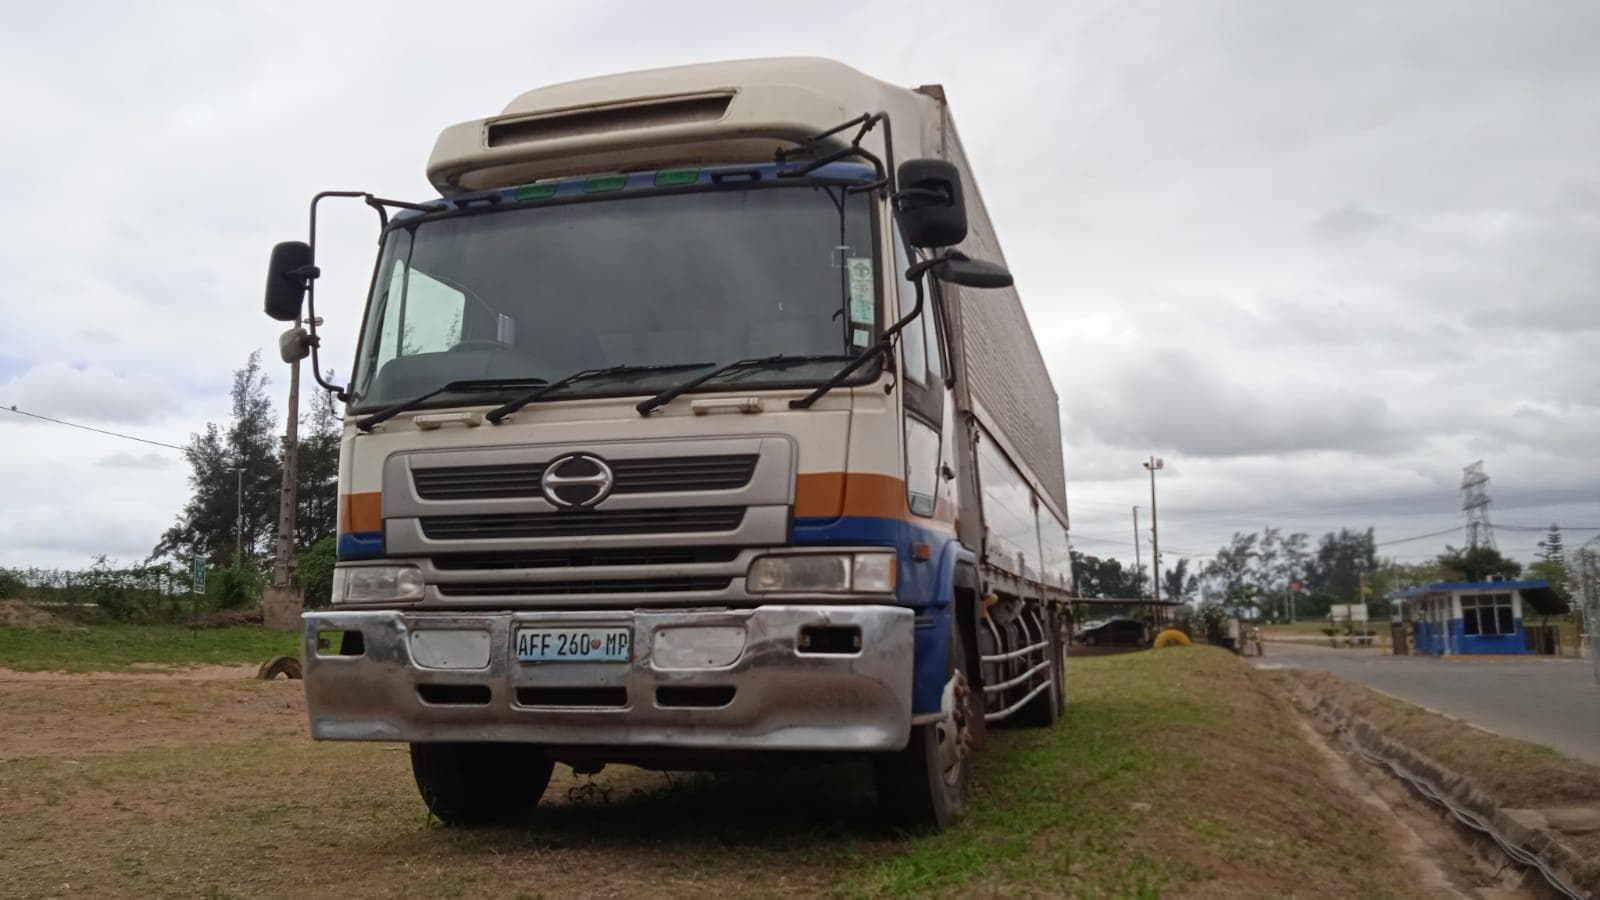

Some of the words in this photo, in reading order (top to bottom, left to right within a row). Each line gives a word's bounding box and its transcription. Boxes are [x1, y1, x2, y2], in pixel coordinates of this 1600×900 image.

[518, 634, 551, 656] AFF
[557, 634, 590, 656] 260
[606, 633, 628, 655] MP
